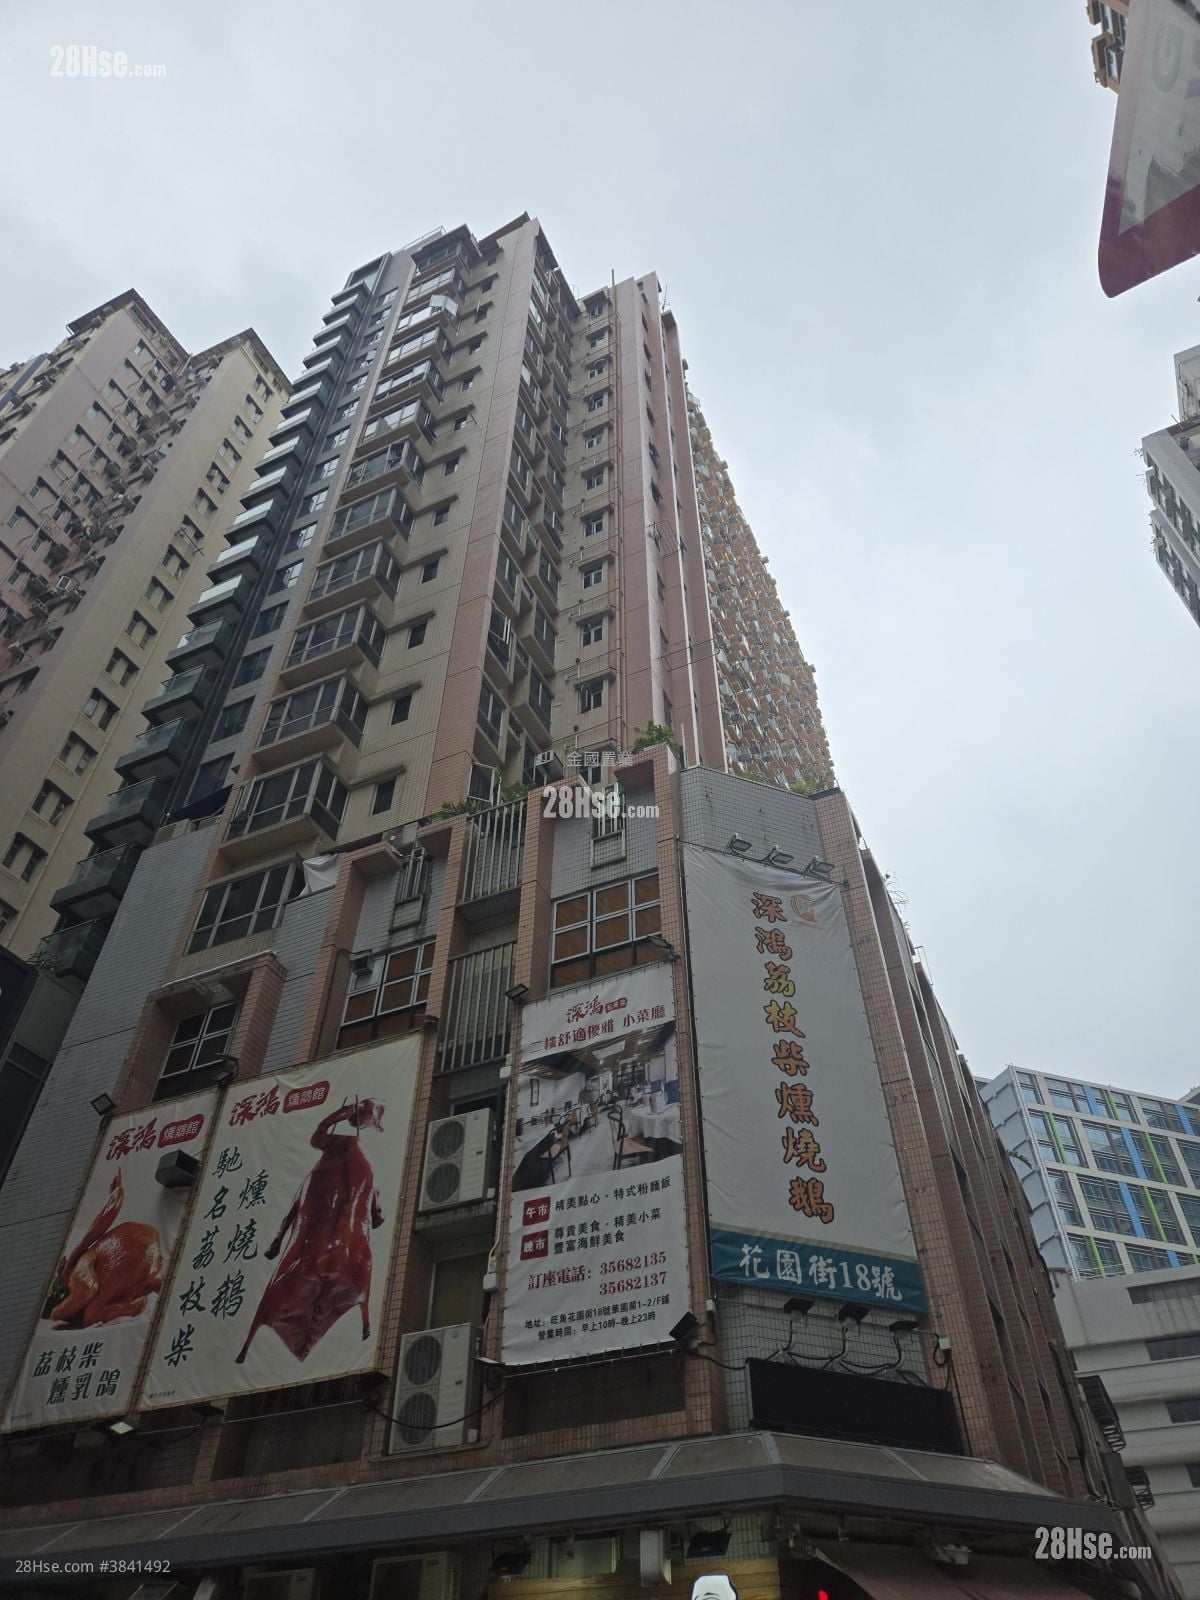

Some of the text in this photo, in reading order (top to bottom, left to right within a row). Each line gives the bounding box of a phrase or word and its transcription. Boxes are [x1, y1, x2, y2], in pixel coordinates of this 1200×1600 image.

[530, 1018, 615, 1054] 二樓舒適優雅
[622, 1004, 666, 1029] 小菜廳
[228, 1084, 281, 1127] 深鴻
[106, 1118, 157, 1161] 深鴻
[526, 1203, 548, 1219] 午市
[523, 1236, 547, 1253] 晚市
[553, 1229, 625, 1256] 豐富海鮮美食
[600, 1250, 667, 1276] 35682135
[739, 1243, 903, 1301] 花園街18號
[599, 1271, 668, 1296] 35682137
[32, 1341, 104, 1378] 荔枝柴
[46, 1368, 121, 1405] 燻乳鴿
